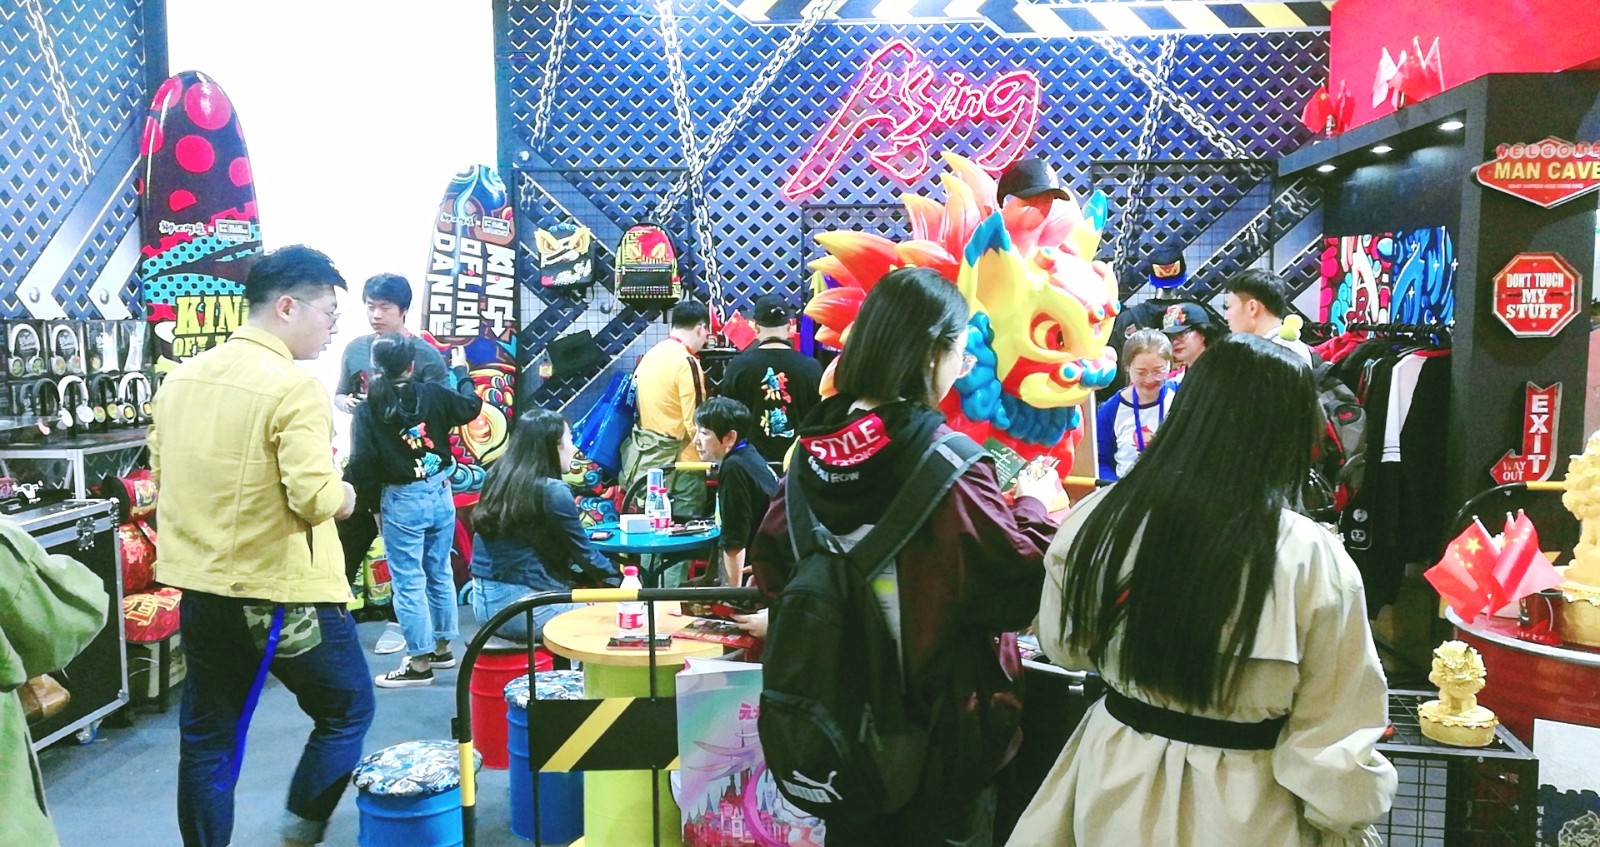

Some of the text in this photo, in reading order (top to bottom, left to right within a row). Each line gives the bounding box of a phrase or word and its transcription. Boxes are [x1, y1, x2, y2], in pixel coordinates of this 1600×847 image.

[1496, 143, 1600, 158] WELCOME
[1494, 162, 1600, 179] MAN CAVE
[426, 232, 456, 336] DANCE
[455, 237, 483, 336] OF LION
[1506, 272, 1564, 288] DON'T TOUCH
[1522, 288, 1547, 303] MY
[1505, 303, 1563, 319] STUFF
[810, 420, 881, 460] STYLE
[1528, 394, 1550, 474] EXIT
[1503, 461, 1527, 471] WAY
[1502, 471, 1524, 481] OUT
